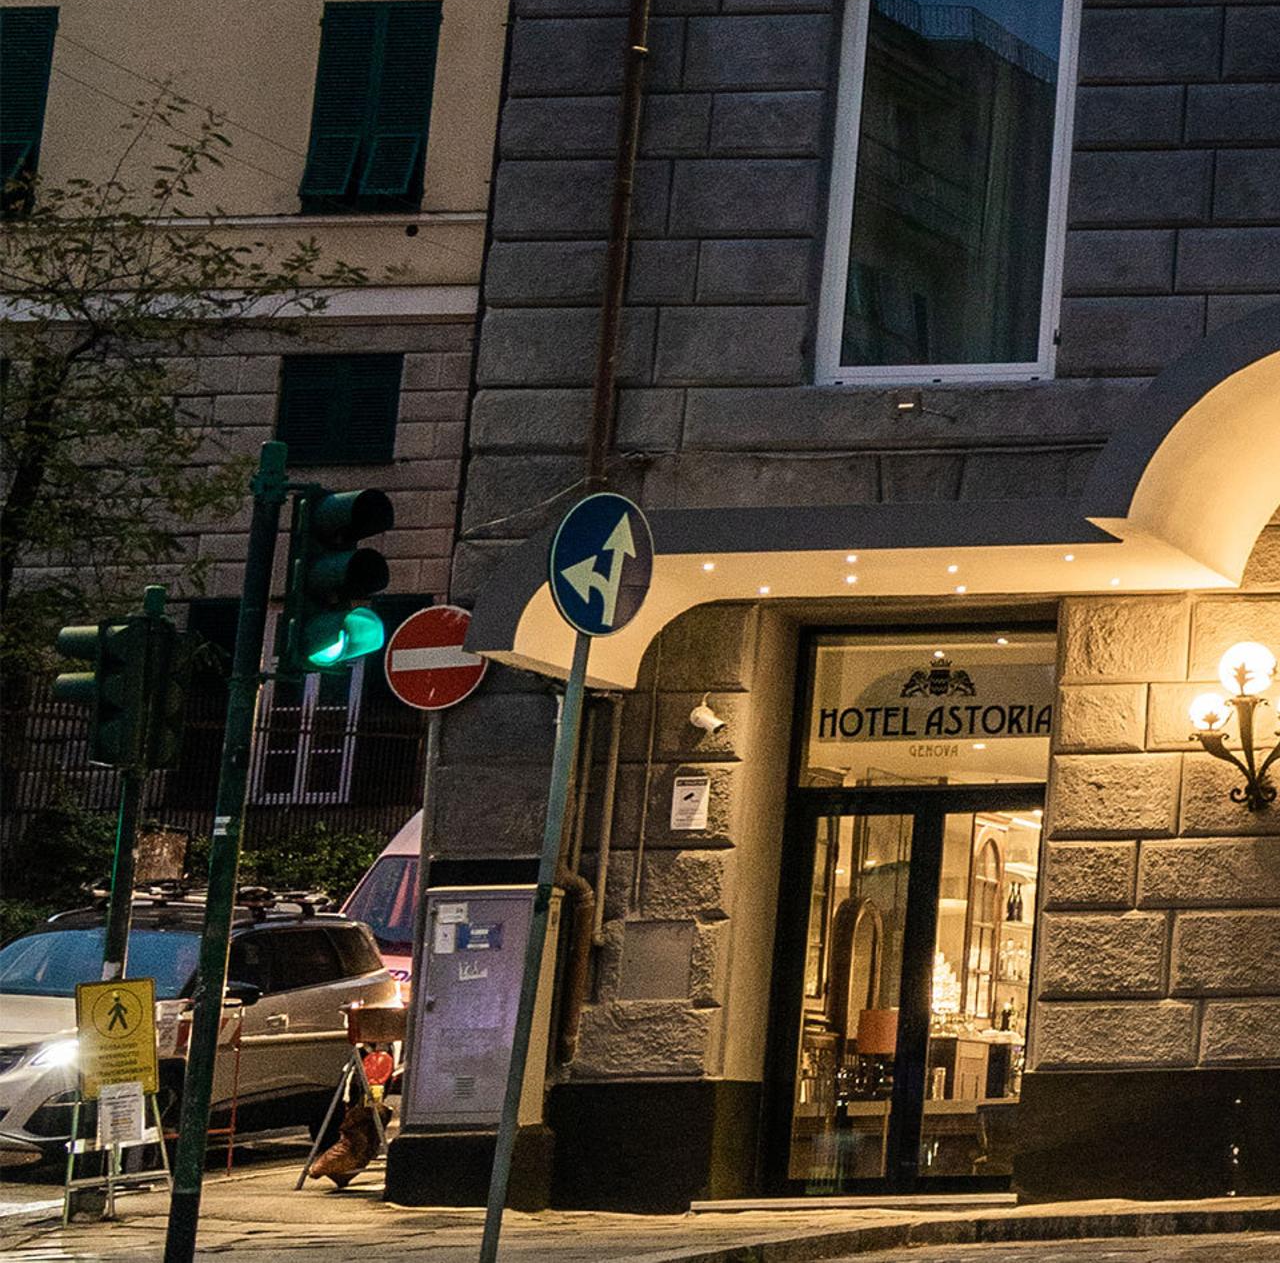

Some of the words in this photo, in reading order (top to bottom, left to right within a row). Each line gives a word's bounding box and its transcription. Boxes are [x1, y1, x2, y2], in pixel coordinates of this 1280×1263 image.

[817, 705, 917, 738] HOTEL
[924, 703, 1053, 737] ASTORIA
[908, 744, 960, 758] GENOVA
